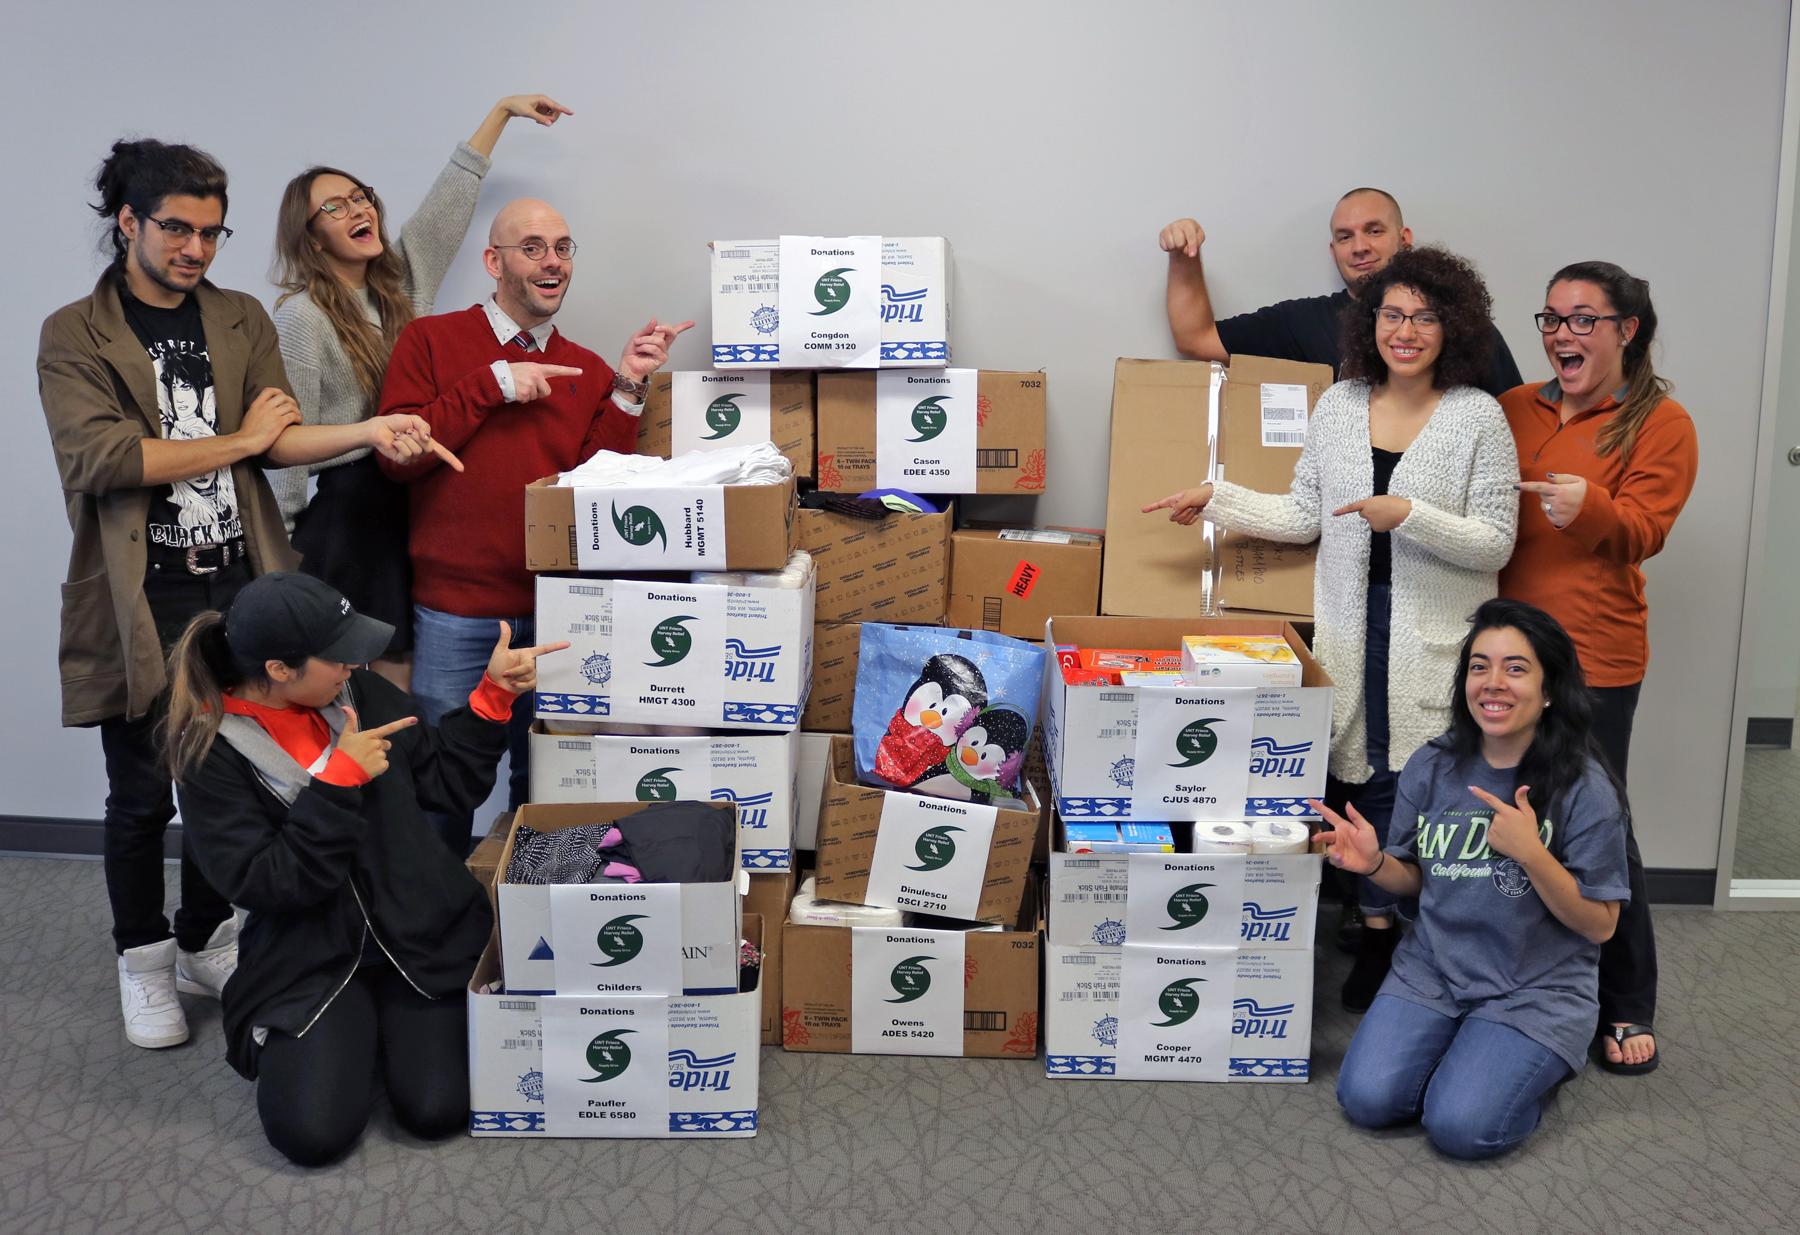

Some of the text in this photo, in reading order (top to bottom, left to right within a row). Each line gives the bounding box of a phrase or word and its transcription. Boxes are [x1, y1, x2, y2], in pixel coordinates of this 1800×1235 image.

[811, 248, 855, 256] Donations
[733, 274, 747, 282] Stick
[811, 331, 849, 340] Congdon
[804, 342, 856, 350] COMM 3120
[907, 376, 951, 384] Donations
[1020, 380, 1041, 388] 7032
[913, 458, 940, 466] Cason
[592, 502, 600, 551] Donations
[696, 498, 706, 556] MGMT 5140
[149, 523, 214, 547] BLACK
[1013, 563, 1036, 597] HEAVY
[647, 592, 697, 602] Donations
[584, 614, 613, 623] Fish Stick
[650, 684, 685, 693] Durrett
[639, 695, 695, 706] HMGT 4300
[1175, 697, 1225, 705] Donations
[630, 746, 680, 755] Donations
[1175, 784, 1207, 793] Saylor
[1162, 795, 1216, 804] CJUS 4870
[918, 800, 967, 816] Donations
[740, 809, 767, 829] Tri
[1164, 863, 1215, 872] Donations
[1431, 863, 1493, 881] California
[900, 885, 948, 900] Dinulescu
[1078, 884, 1093, 892] Stick
[1095, 884, 1108, 892] Fish
[590, 893, 646, 902] Donations
[897, 896, 947, 911] DSCI 2710
[886, 935, 935, 944] Donations
[1010, 940, 1034, 949] 7032
[1157, 957, 1206, 966] Donations
[597, 983, 642, 991] Childers
[1076, 982, 1106, 990] Fish Stick
[580, 1007, 635, 1016] Donations
[891, 1019, 924, 1027] Owens
[519, 1029, 536, 1037] Stick
[881, 1030, 934, 1038] ADES 5420
[1156, 1043, 1191, 1053] Cooper
[1144, 1054, 1202, 1064] MGMT 4470
[578, 1111, 636, 1119] EDLE 6580
